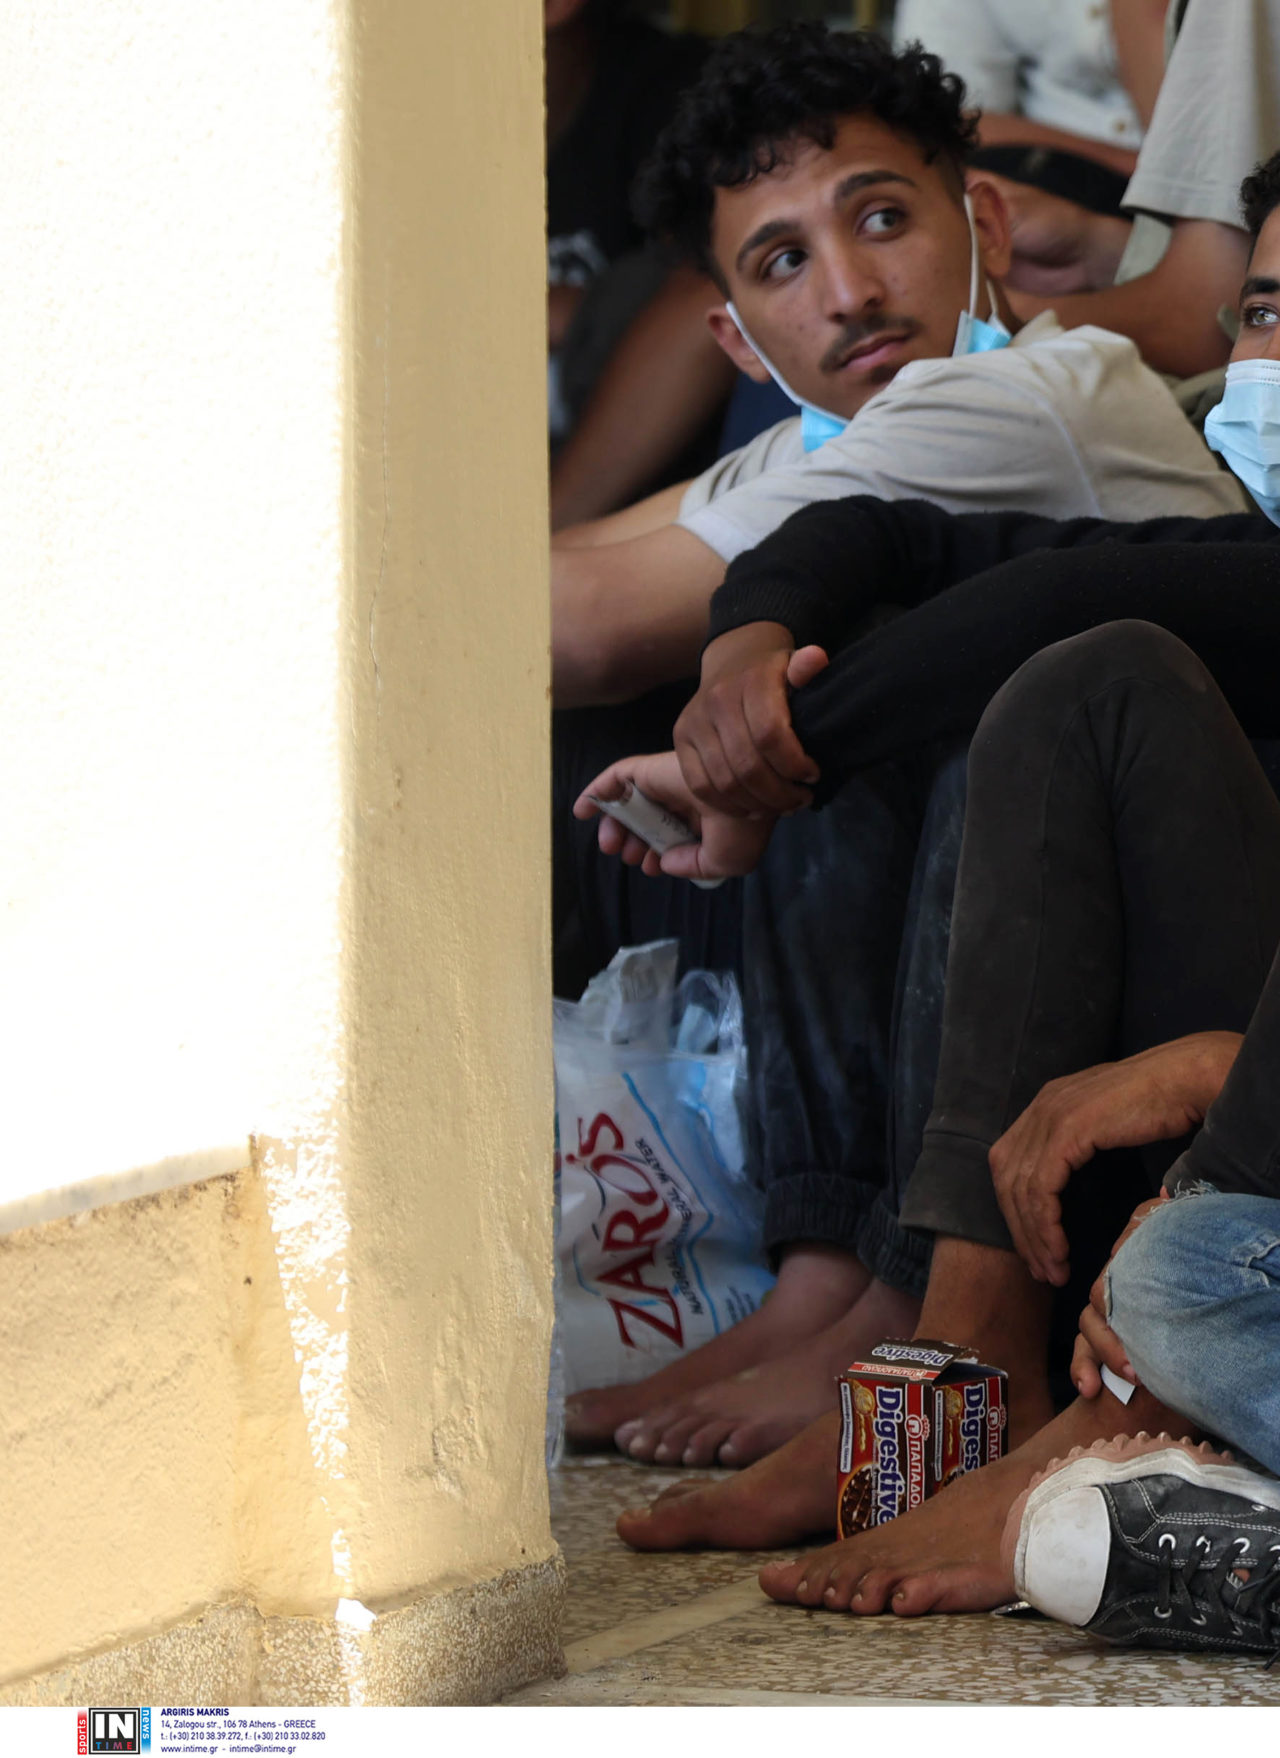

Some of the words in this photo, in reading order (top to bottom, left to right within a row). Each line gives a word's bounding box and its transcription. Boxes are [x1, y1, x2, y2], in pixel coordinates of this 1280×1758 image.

[635, 1137, 669, 1184] WATER
[872, 1346, 953, 1366] Digestive
[873, 1387, 905, 1524] Digestive
